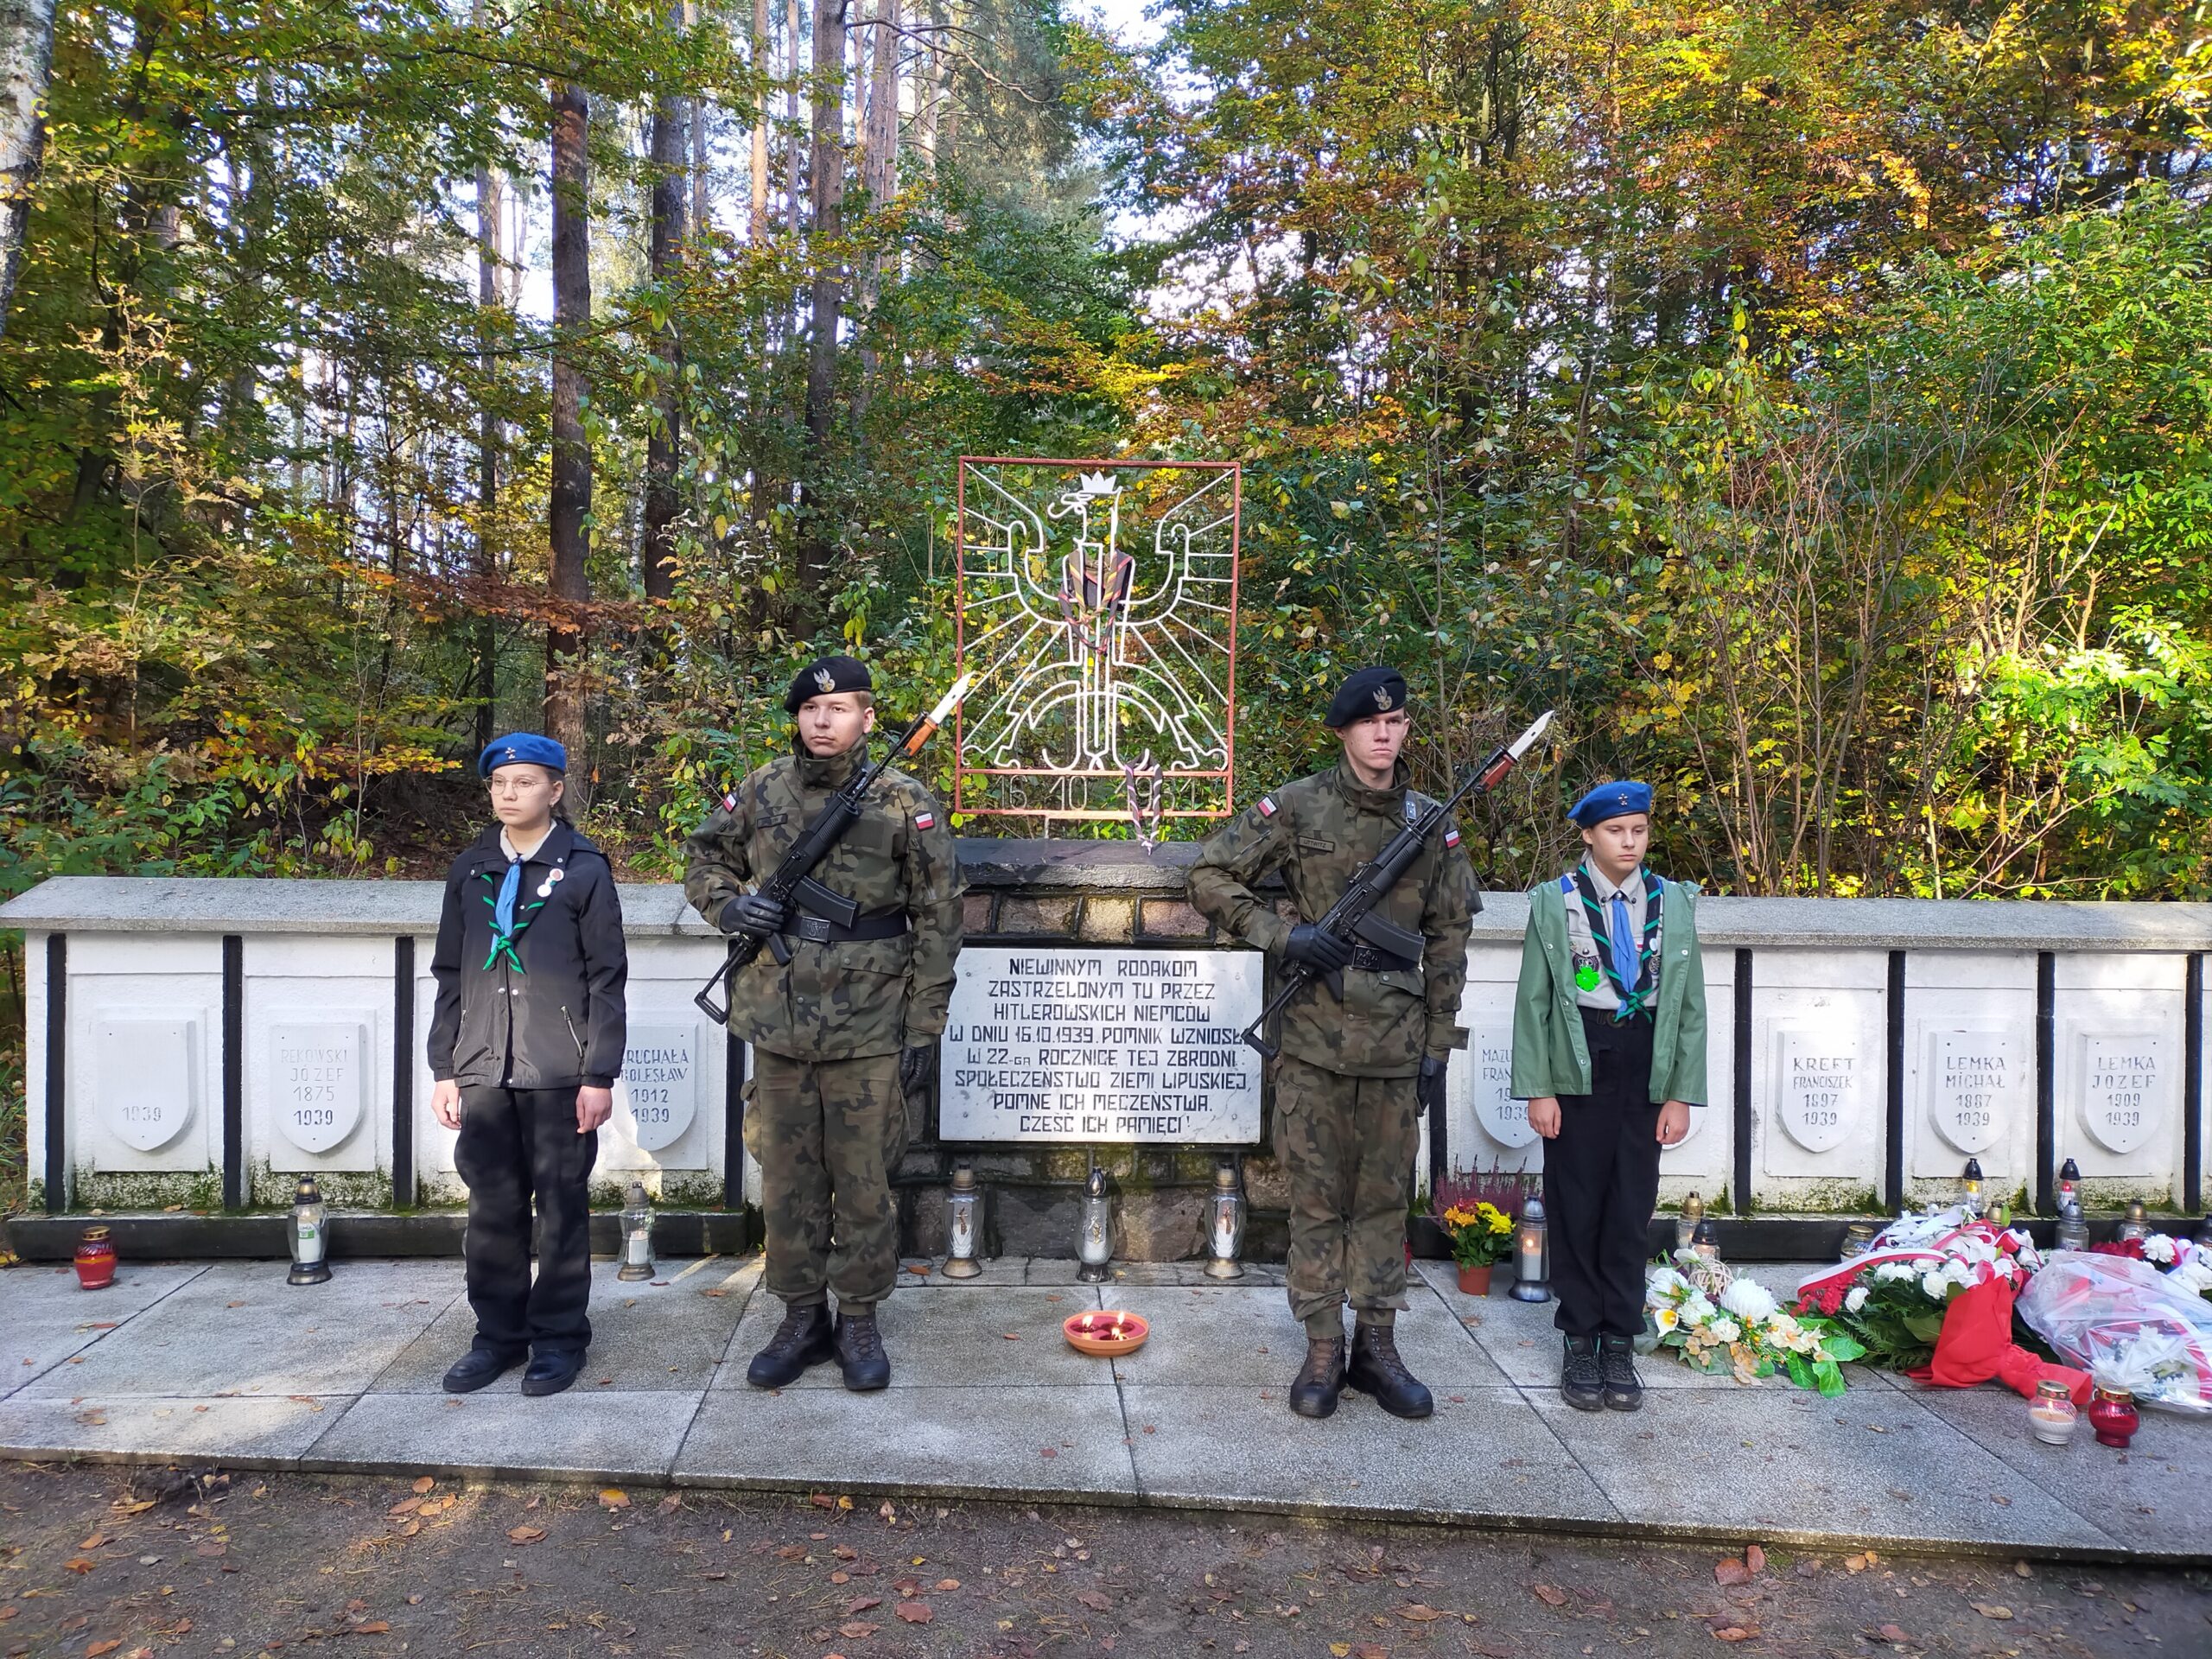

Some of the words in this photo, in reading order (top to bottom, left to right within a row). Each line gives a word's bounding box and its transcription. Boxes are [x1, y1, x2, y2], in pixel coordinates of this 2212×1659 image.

[1009, 958, 1102, 976] NIEWINNYM
[1117, 959, 1198, 976] RODAKOM
[988, 980, 1123, 999] ZASTRZELONYM
[1132, 982, 1153, 999] TU
[1161, 982, 1216, 1000] PRZEZ
[994, 1003, 1126, 1021] HITLEROWSKICH
[950, 1025, 963, 1042] W
[972, 1025, 1008, 1042] DNIU
[1102, 1027, 1162, 1044] POMNIK
[1171, 1028, 1249, 1046] WZNIOSŁ
[622, 1048, 690, 1064] RUCHAŁA
[967, 1047, 982, 1065] W
[1127, 1050, 1159, 1066] TEJ
[1793, 1057, 1857, 1071] KREFT
[1946, 1056, 2006, 1071] LEMKA
[2097, 1056, 2156, 1071] LEMKA
[1110, 1071, 1154, 1089] ZIEMI
[1793, 1075, 1854, 1090] FRANCISZEK
[293, 1085, 335, 1102] 1875
[631, 1089, 669, 1103] 1912
[994, 1093, 1052, 1110] POMNE
[1059, 1093, 1085, 1110] ICH
[1802, 1093, 1839, 1108] 1897
[1955, 1094, 1993, 1109] 1887
[2107, 1093, 2141, 1107] 1909
[122, 1106, 162, 1122] 1939
[293, 1109, 334, 1126] 1939
[631, 1108, 670, 1122] 1939
[1802, 1111, 1838, 1126] 1939
[1955, 1111, 1991, 1127] 1939
[2105, 1111, 2140, 1127] 1939
[1082, 1116, 1108, 1133] ICH
